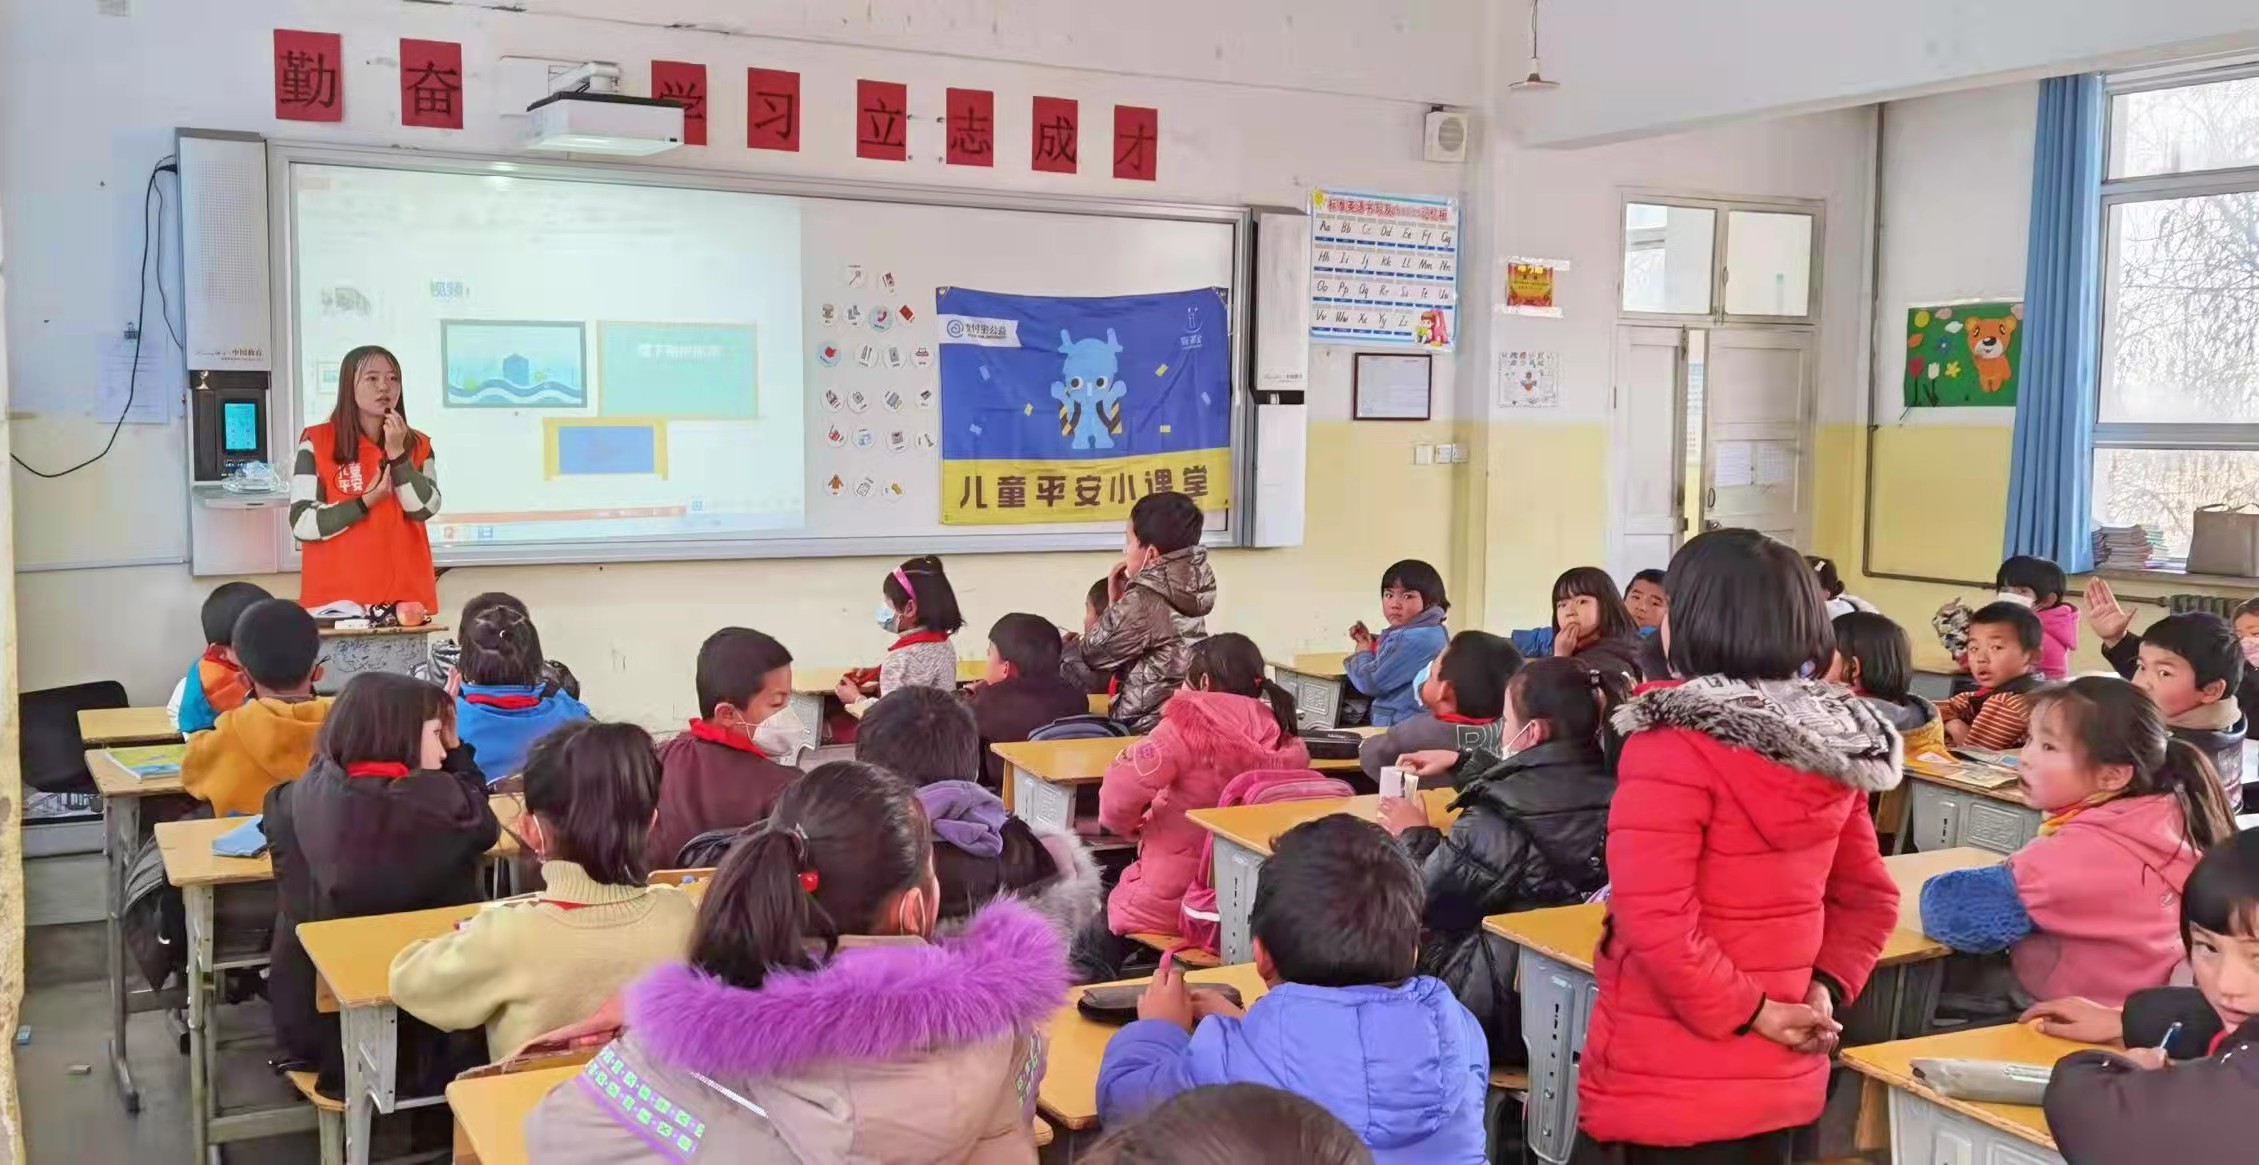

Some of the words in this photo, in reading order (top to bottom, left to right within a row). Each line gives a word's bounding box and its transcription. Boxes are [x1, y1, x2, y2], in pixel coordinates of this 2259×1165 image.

[1319, 220, 1331, 233] Aa
[1340, 221, 1352, 234] Bb
[1380, 225, 1393, 237] Dd
[1402, 228, 1412, 239] Ee
[1318, 251, 1330, 263] Hh
[1340, 252, 1349, 264] Ii
[1380, 255, 1392, 267] Kk
[1401, 257, 1411, 269] Ll
[1419, 259, 1433, 270] Mm
[1440, 260, 1451, 271] Nn
[1316, 279, 1329, 292] Oo
[1337, 281, 1349, 297] Pp
[1315, 308, 1327, 321] Vv
[1335, 310, 1349, 323] Ww
[1357, 311, 1368, 324] Xx
[1378, 313, 1387, 329] Yy
[960, 465, 1209, 509] 儿童平安小课堂
